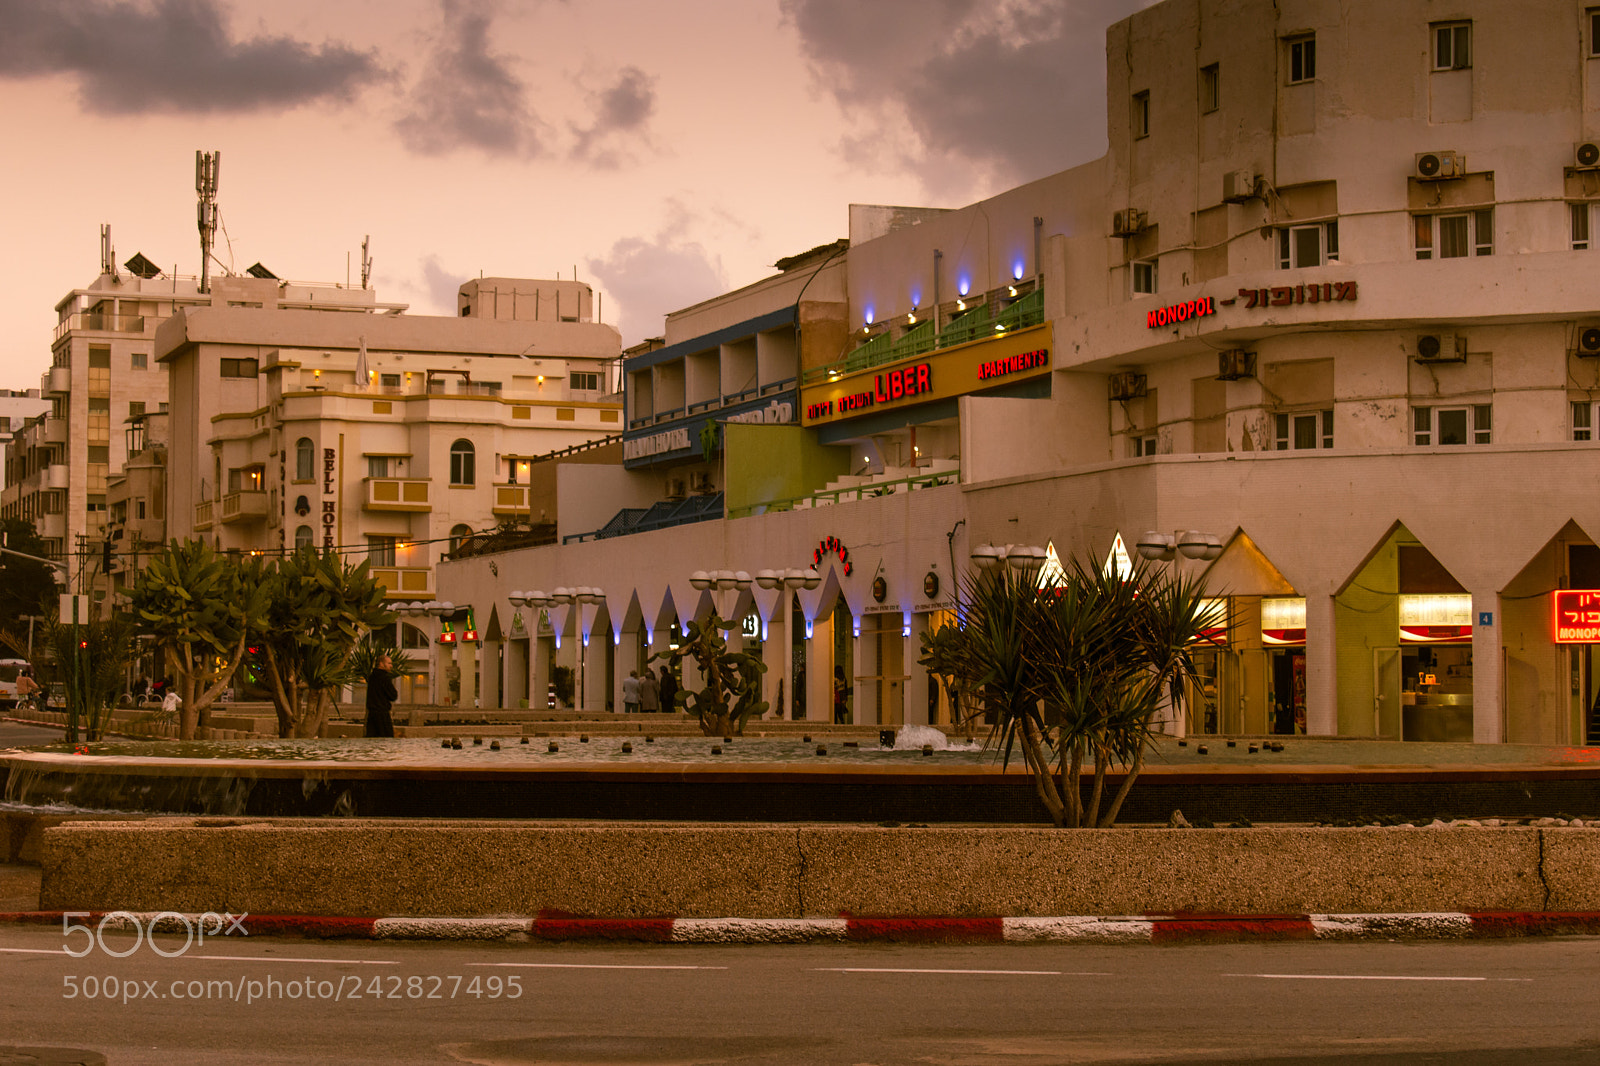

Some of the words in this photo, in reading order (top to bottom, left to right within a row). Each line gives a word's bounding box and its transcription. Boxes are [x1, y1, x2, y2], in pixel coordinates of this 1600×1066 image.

[1238, 281, 1357, 309] מונופול
[1147, 296, 1214, 329] MONOPOL
[875, 363, 932, 403] LIBER
[977, 348, 1048, 380] APARTMENTS
[807, 401, 832, 419] דירות
[837, 391, 873, 413] השכרת
[323, 448, 336, 495] BELL
[322, 501, 336, 550] HOTE
[1482, 615, 1489, 623] 4
